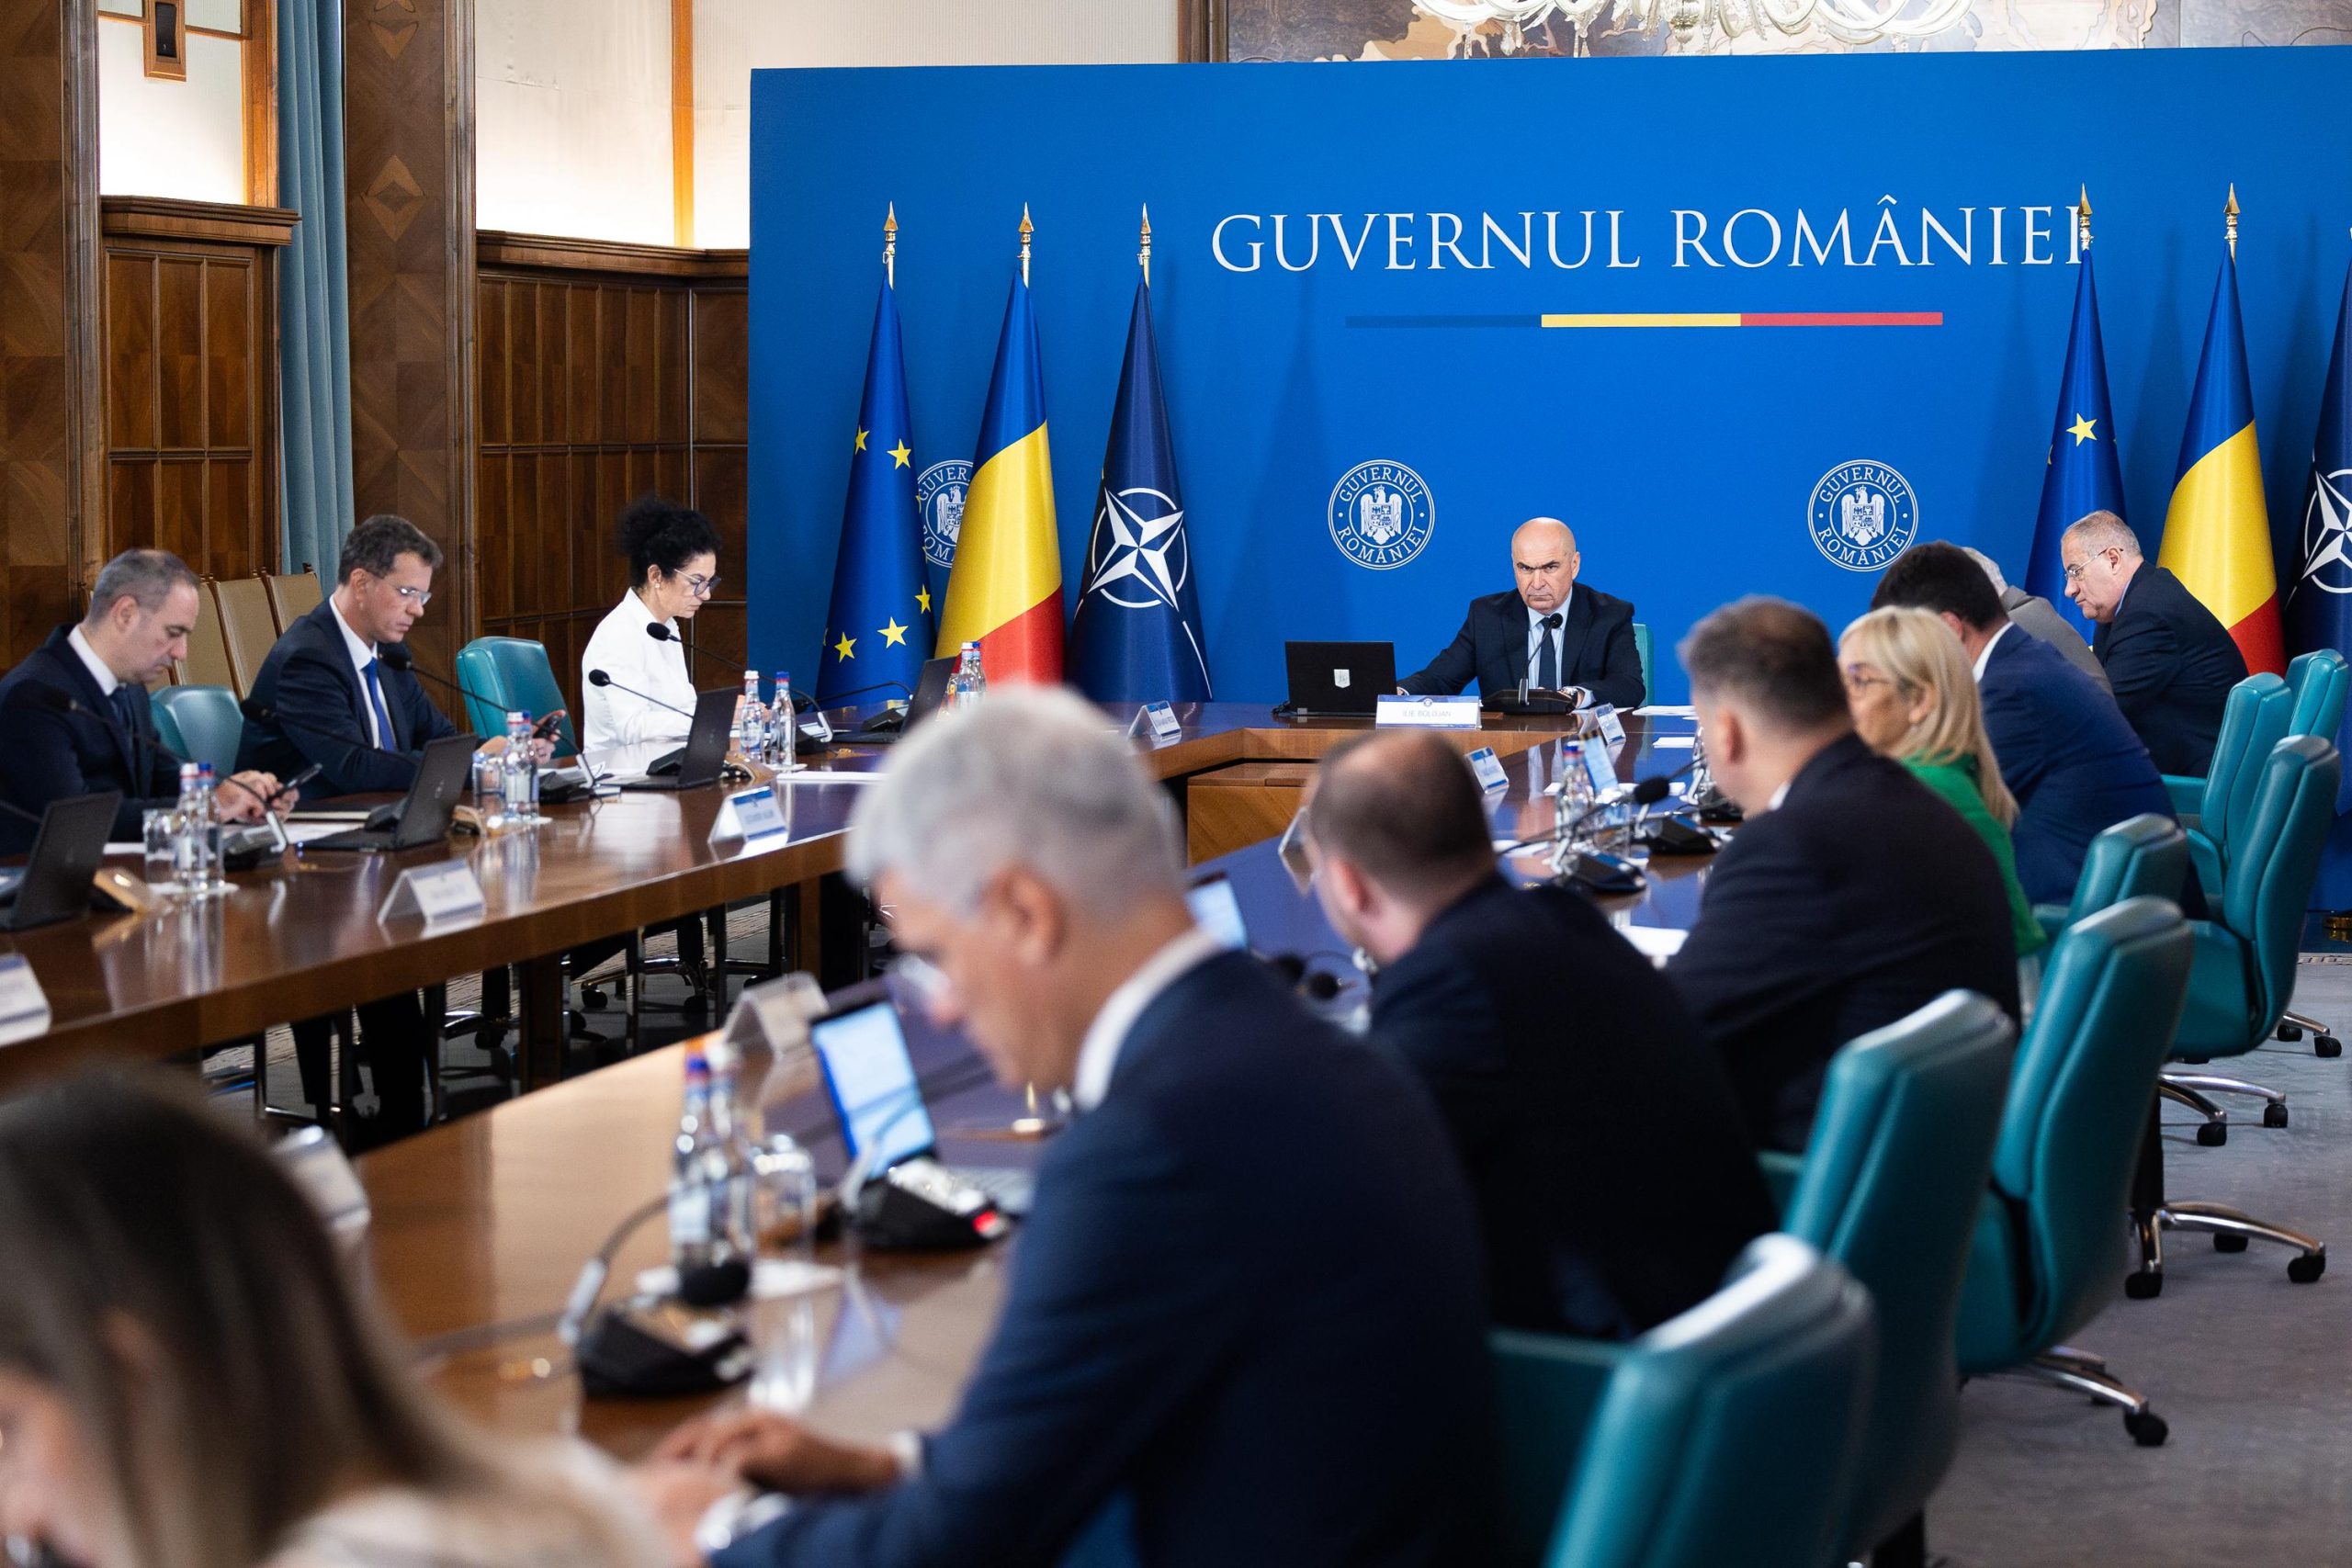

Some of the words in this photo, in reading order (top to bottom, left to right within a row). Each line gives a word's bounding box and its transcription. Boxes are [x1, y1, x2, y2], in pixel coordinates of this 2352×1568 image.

[1213, 211, 1639, 271] GUVERNUL
[1671, 195, 2082, 267] ROMÂNIEI
[919, 467, 970, 501] GUVER
[1340, 467, 1423, 502] GUVERNUL
[1819, 467, 1906, 503] GUVERNUL
[1338, 526, 1426, 563] ROMÂNIEI
[1818, 527, 1909, 565] ROMÂNIEI
